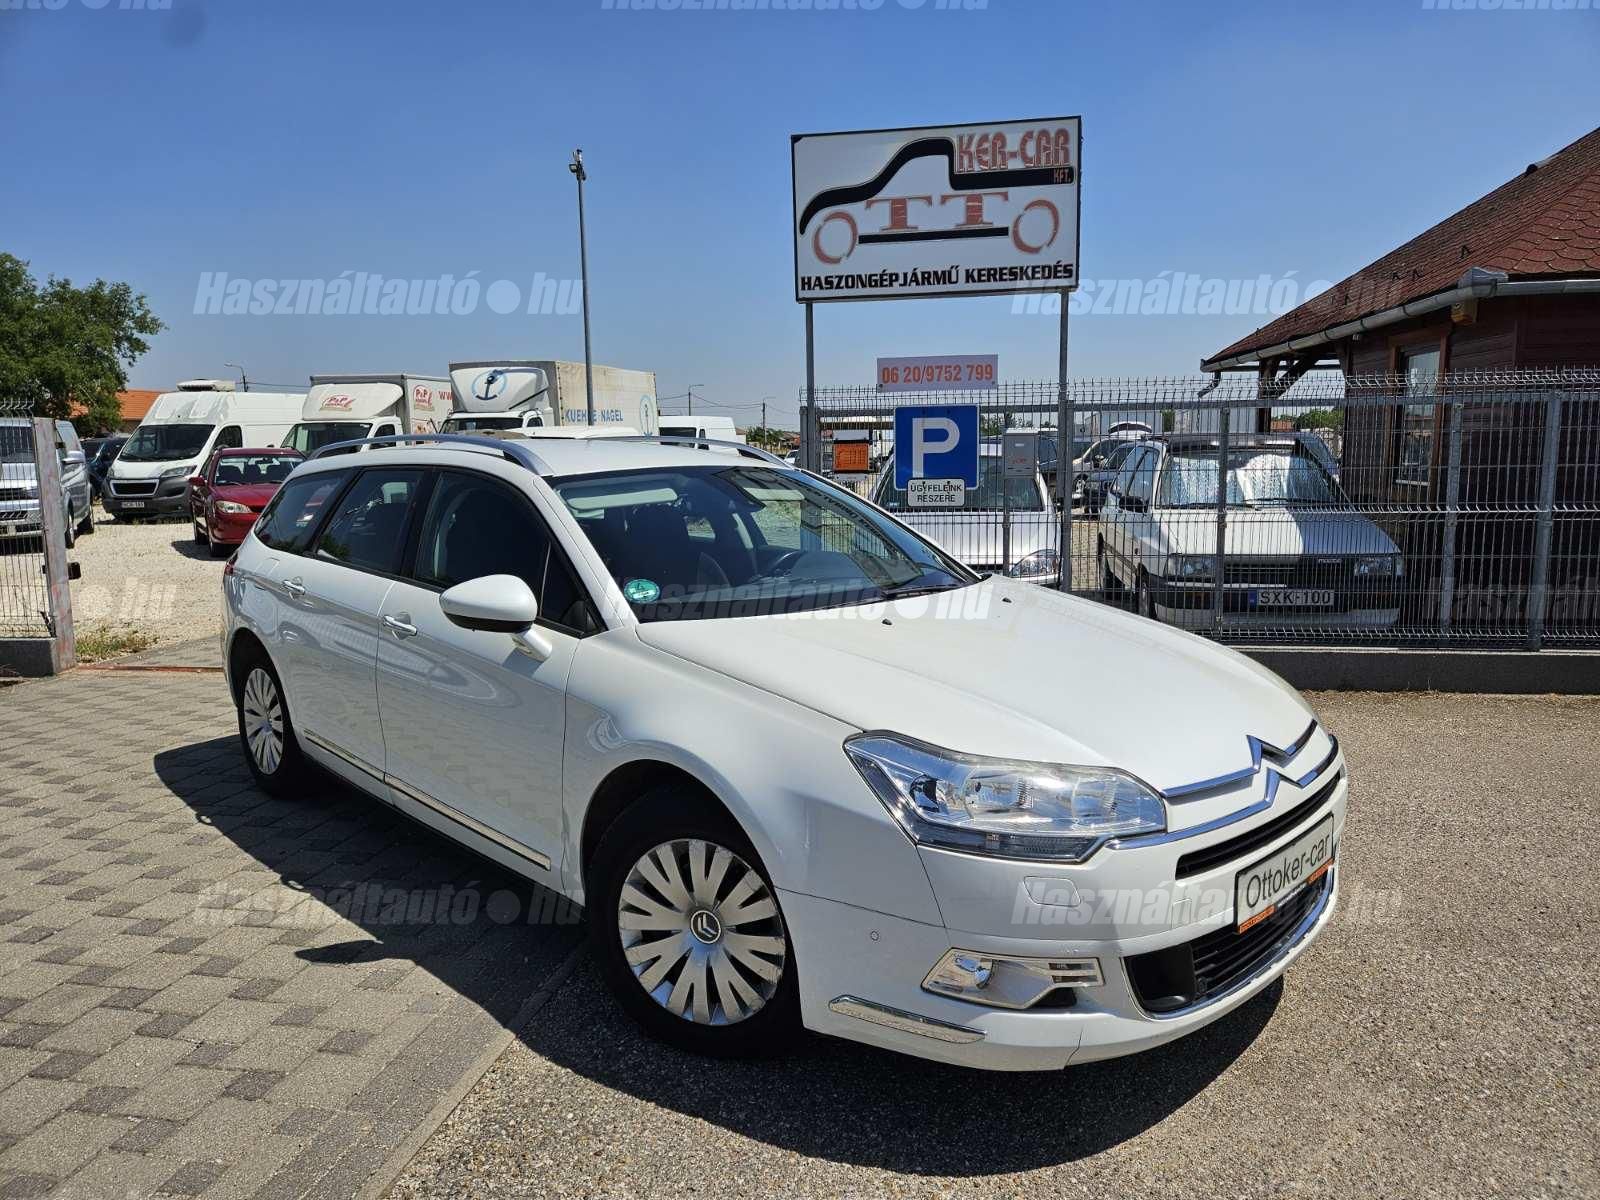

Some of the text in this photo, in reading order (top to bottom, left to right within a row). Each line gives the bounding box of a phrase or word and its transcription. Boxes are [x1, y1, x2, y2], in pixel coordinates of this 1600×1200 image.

[957, 128, 1070, 171] KER-CAR
[801, 260, 1073, 291] HASZONGÉPJÁRMŰ KERESKEDÉS
[881, 364, 993, 385] 06 20/9752 799
[912, 417, 960, 478] P
[1260, 591, 1330, 605] SXK-100
[1246, 834, 1330, 908] Ottoker-car
